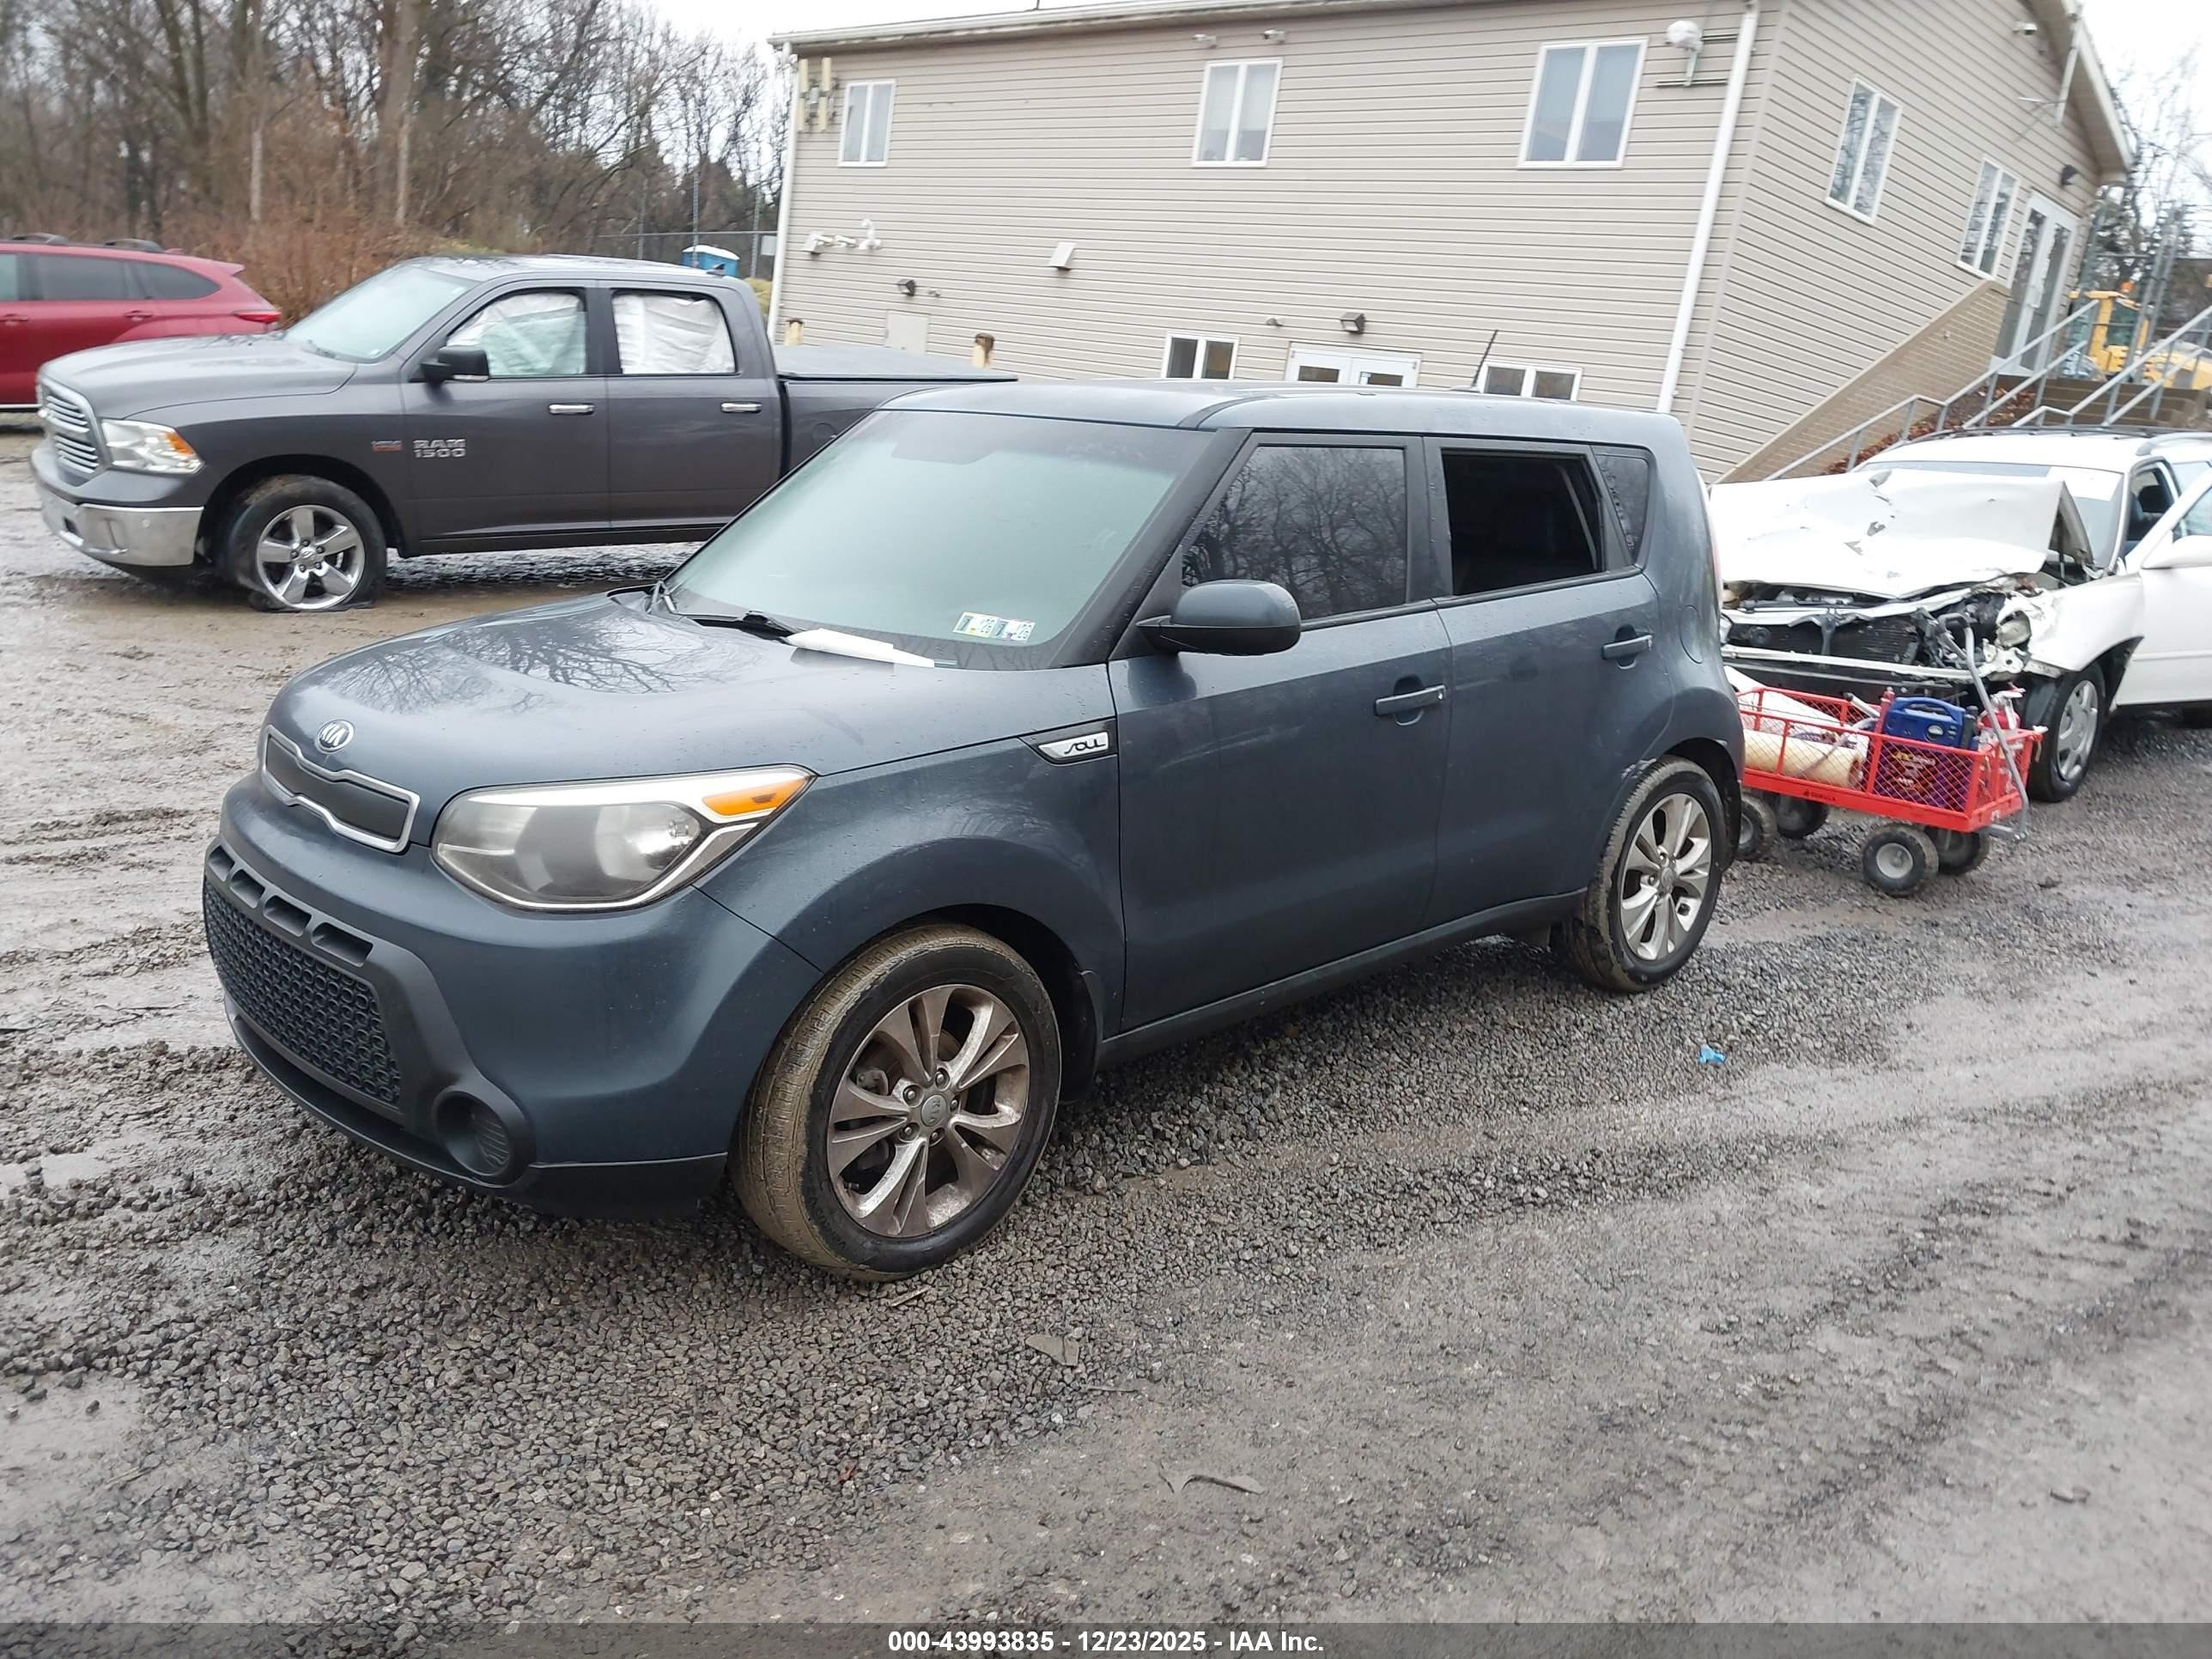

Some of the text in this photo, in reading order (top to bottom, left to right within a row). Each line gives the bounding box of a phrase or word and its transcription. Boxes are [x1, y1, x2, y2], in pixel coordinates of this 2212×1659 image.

[413, 439, 465, 447] RAM
[413, 448, 465, 458] 1500
[321, 723, 348, 747] KIA
